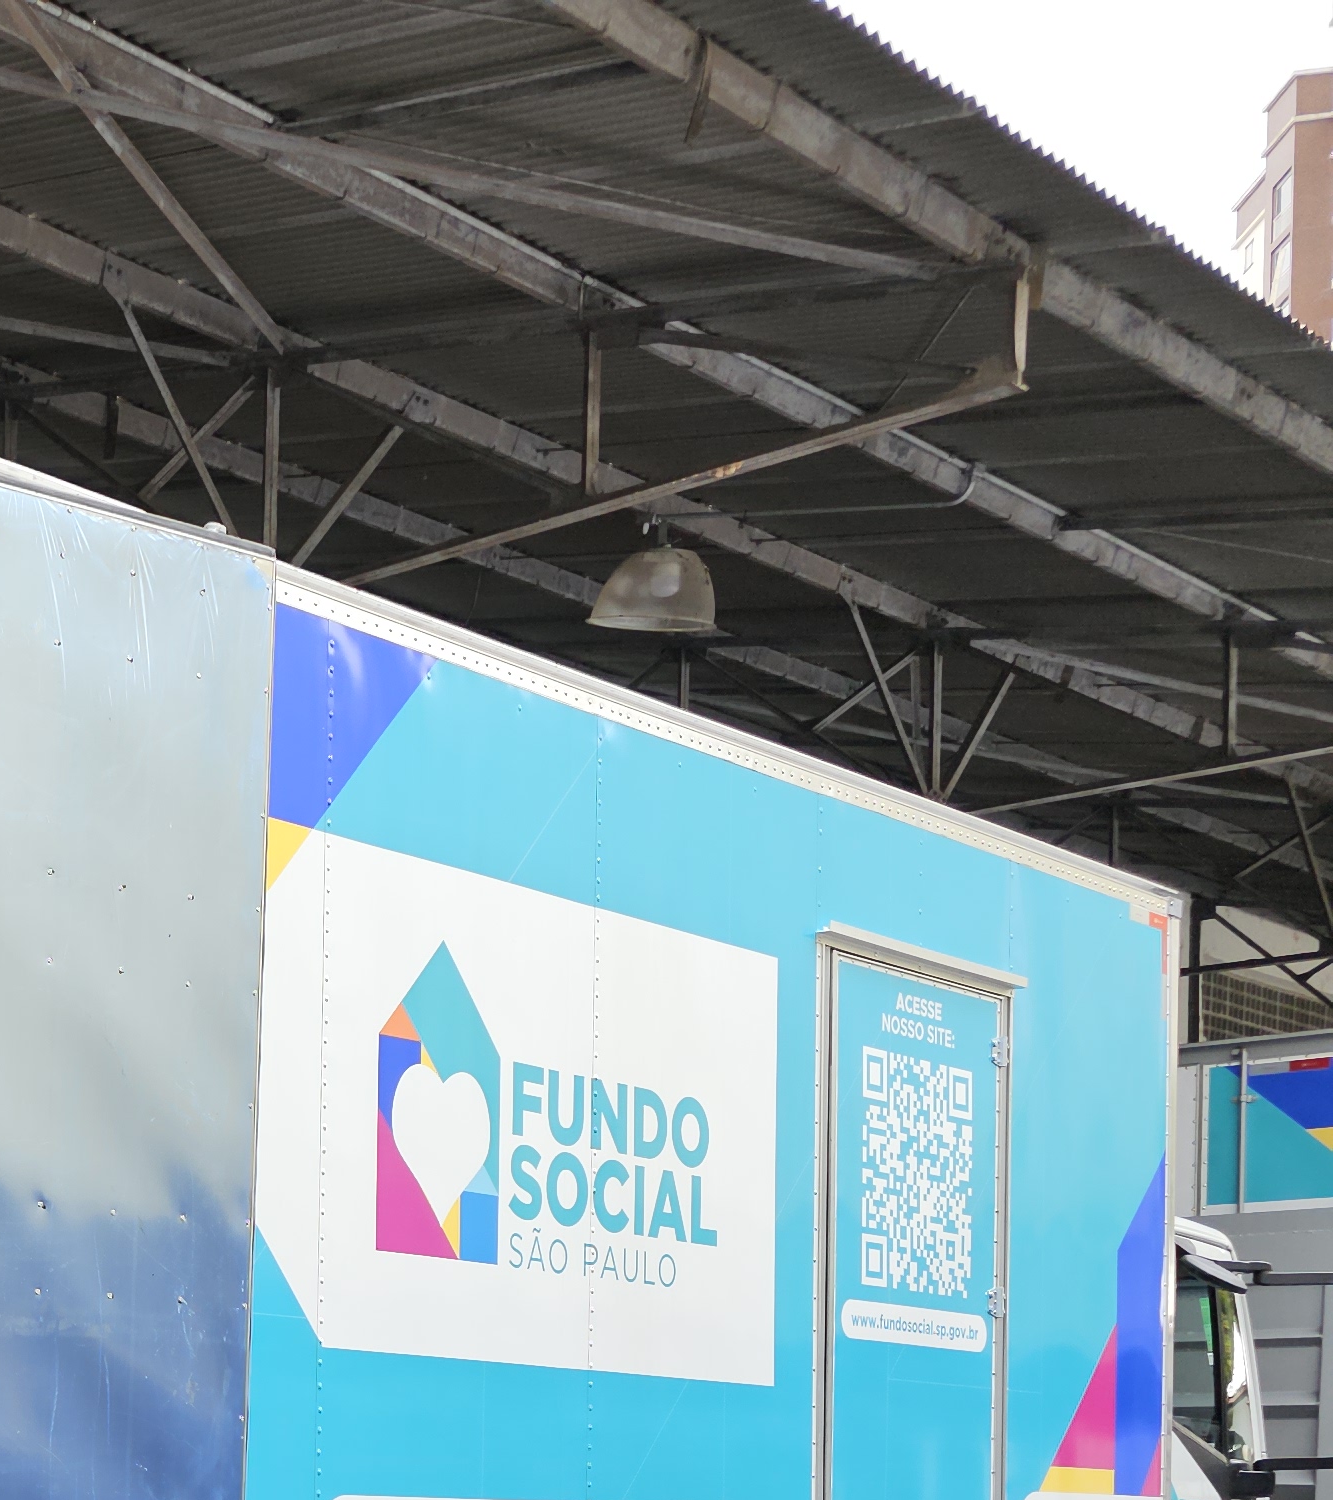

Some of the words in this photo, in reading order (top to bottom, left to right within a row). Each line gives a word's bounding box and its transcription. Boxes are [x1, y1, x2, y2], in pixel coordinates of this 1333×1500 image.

[881, 1012, 924, 1040] NOSSO
[927, 1025, 955, 1049] SITE:
[895, 992, 943, 1021] ACESSE
[512, 1061, 709, 1168] FUNDO
[509, 1144, 717, 1247] SOCIAL
[509, 1228, 567, 1274] SÃO
[583, 1243, 677, 1288] PAULO
[851, 1314, 979, 1340] www.fundosocial.sp.gov.br
